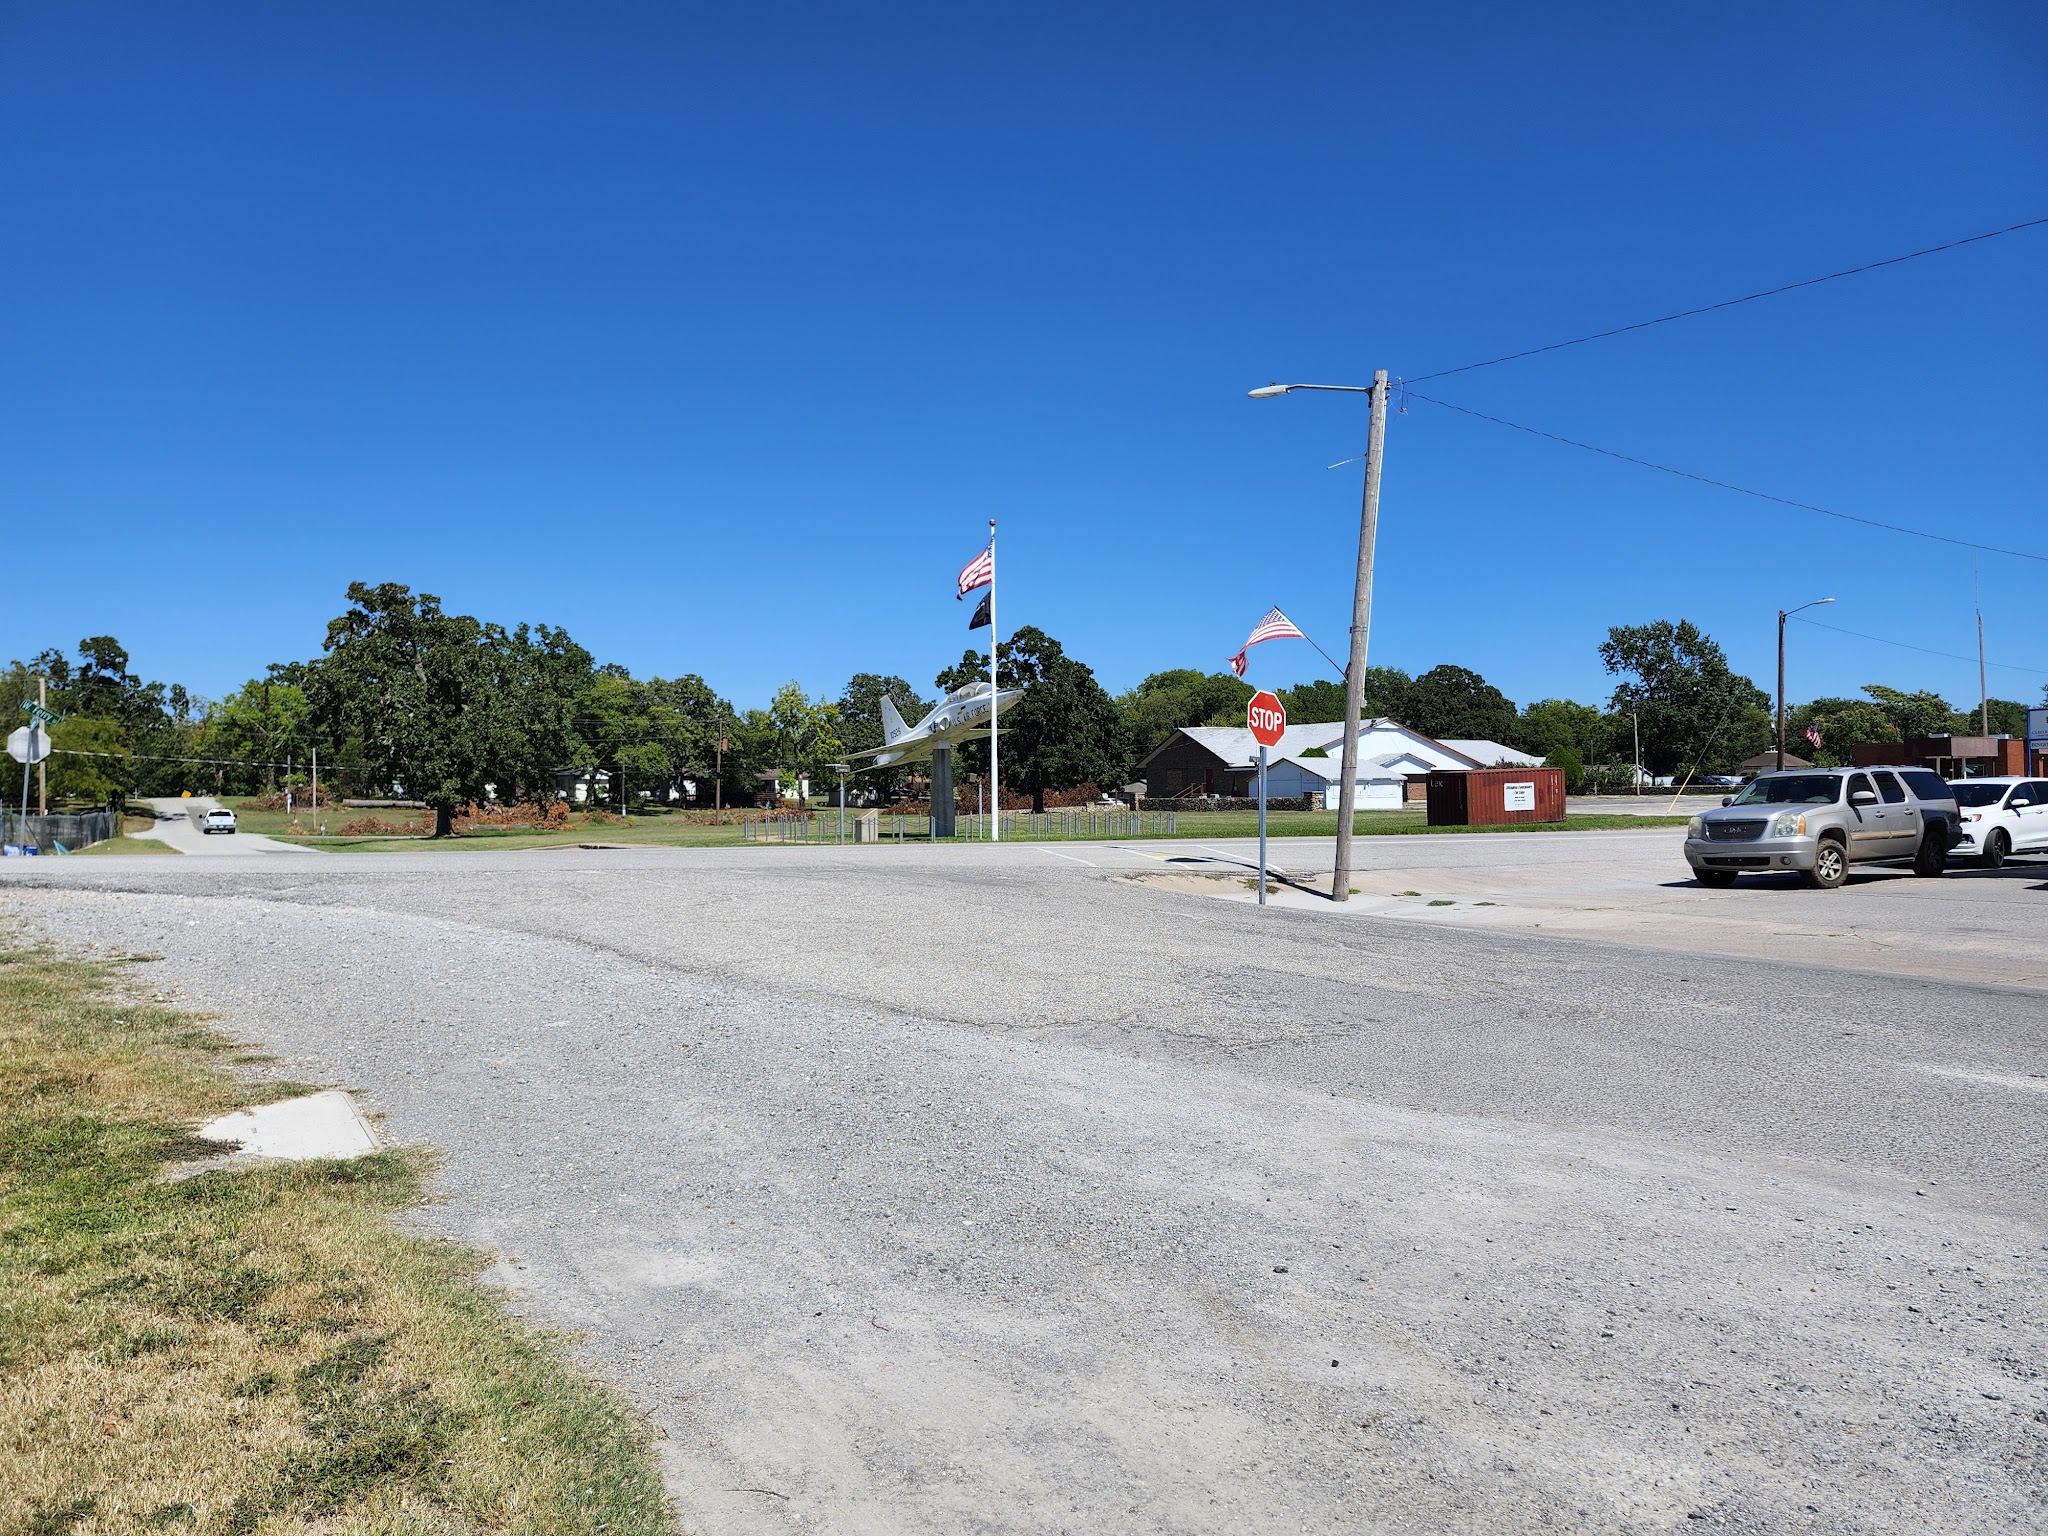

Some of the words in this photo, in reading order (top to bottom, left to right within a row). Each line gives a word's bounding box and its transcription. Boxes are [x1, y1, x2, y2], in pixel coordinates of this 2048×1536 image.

[32, 706, 54, 721] Ferry
[970, 704, 989, 718] FORCE
[1251, 706, 1283, 732] STOP
